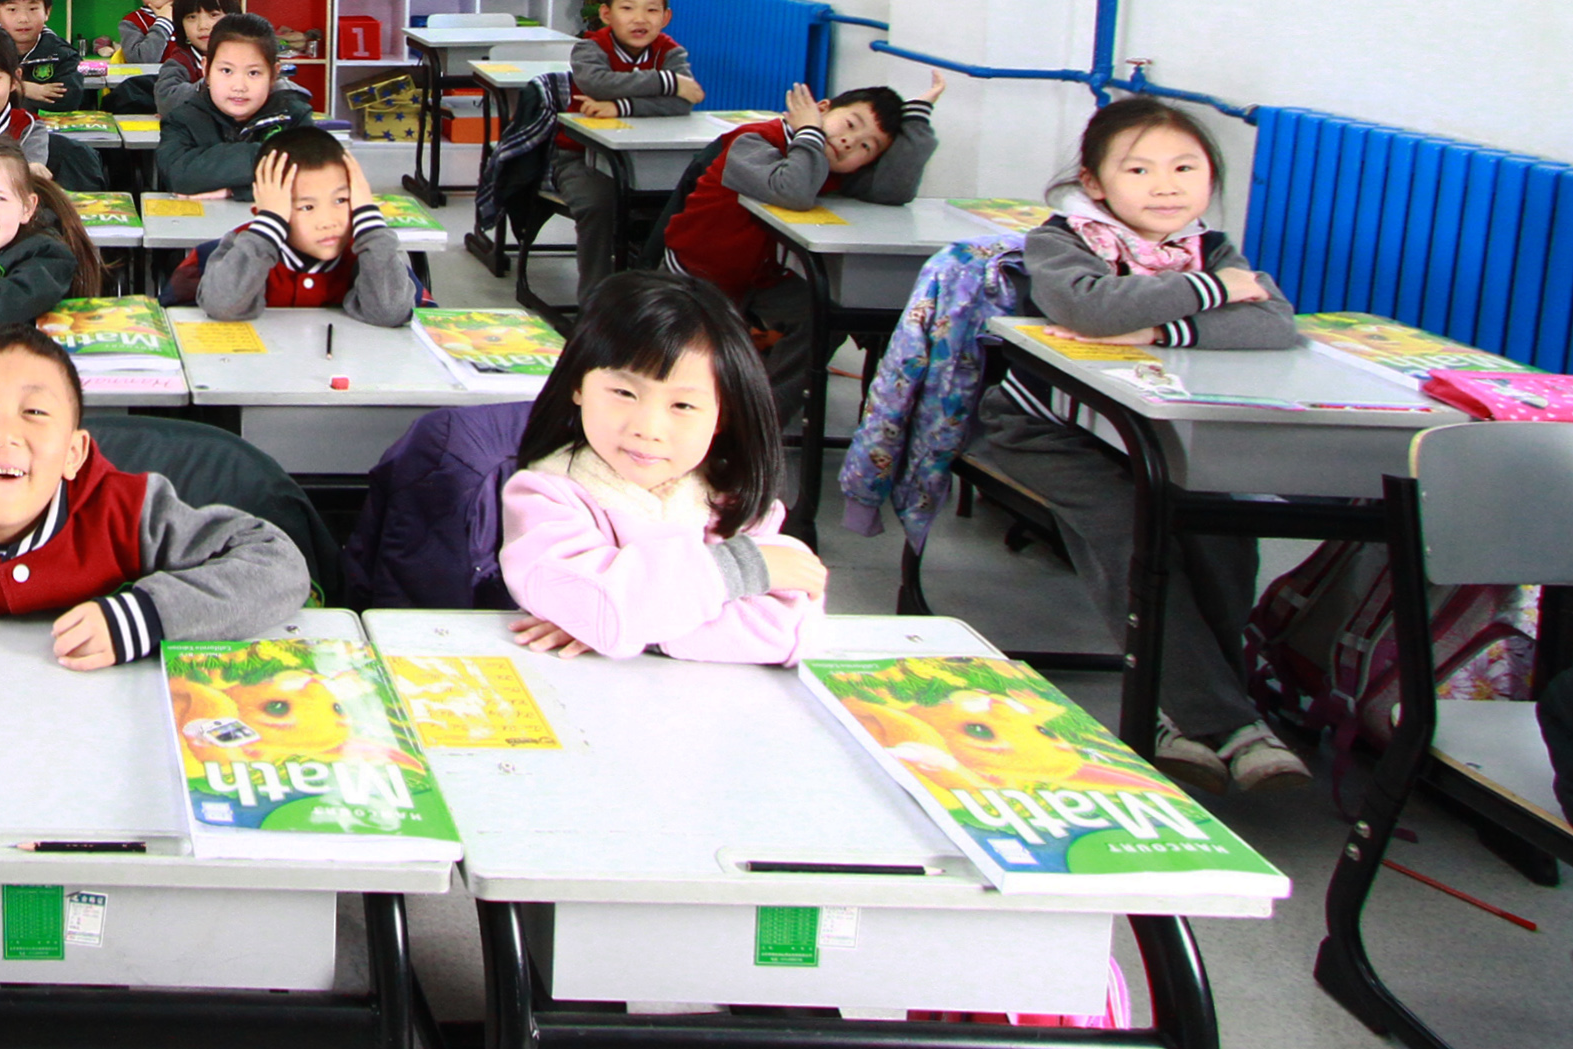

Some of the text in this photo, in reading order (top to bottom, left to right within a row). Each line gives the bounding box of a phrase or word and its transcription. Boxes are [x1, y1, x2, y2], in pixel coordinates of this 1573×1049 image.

[351, 27, 370, 57] 1
[80, 214, 128, 223] Ma
[51, 331, 159, 348] Math
[1375, 354, 1526, 370] Math
[203, 760, 414, 810] Math
[949, 789, 1211, 845] Math
[1106, 841, 1230, 855] HARCOURT
